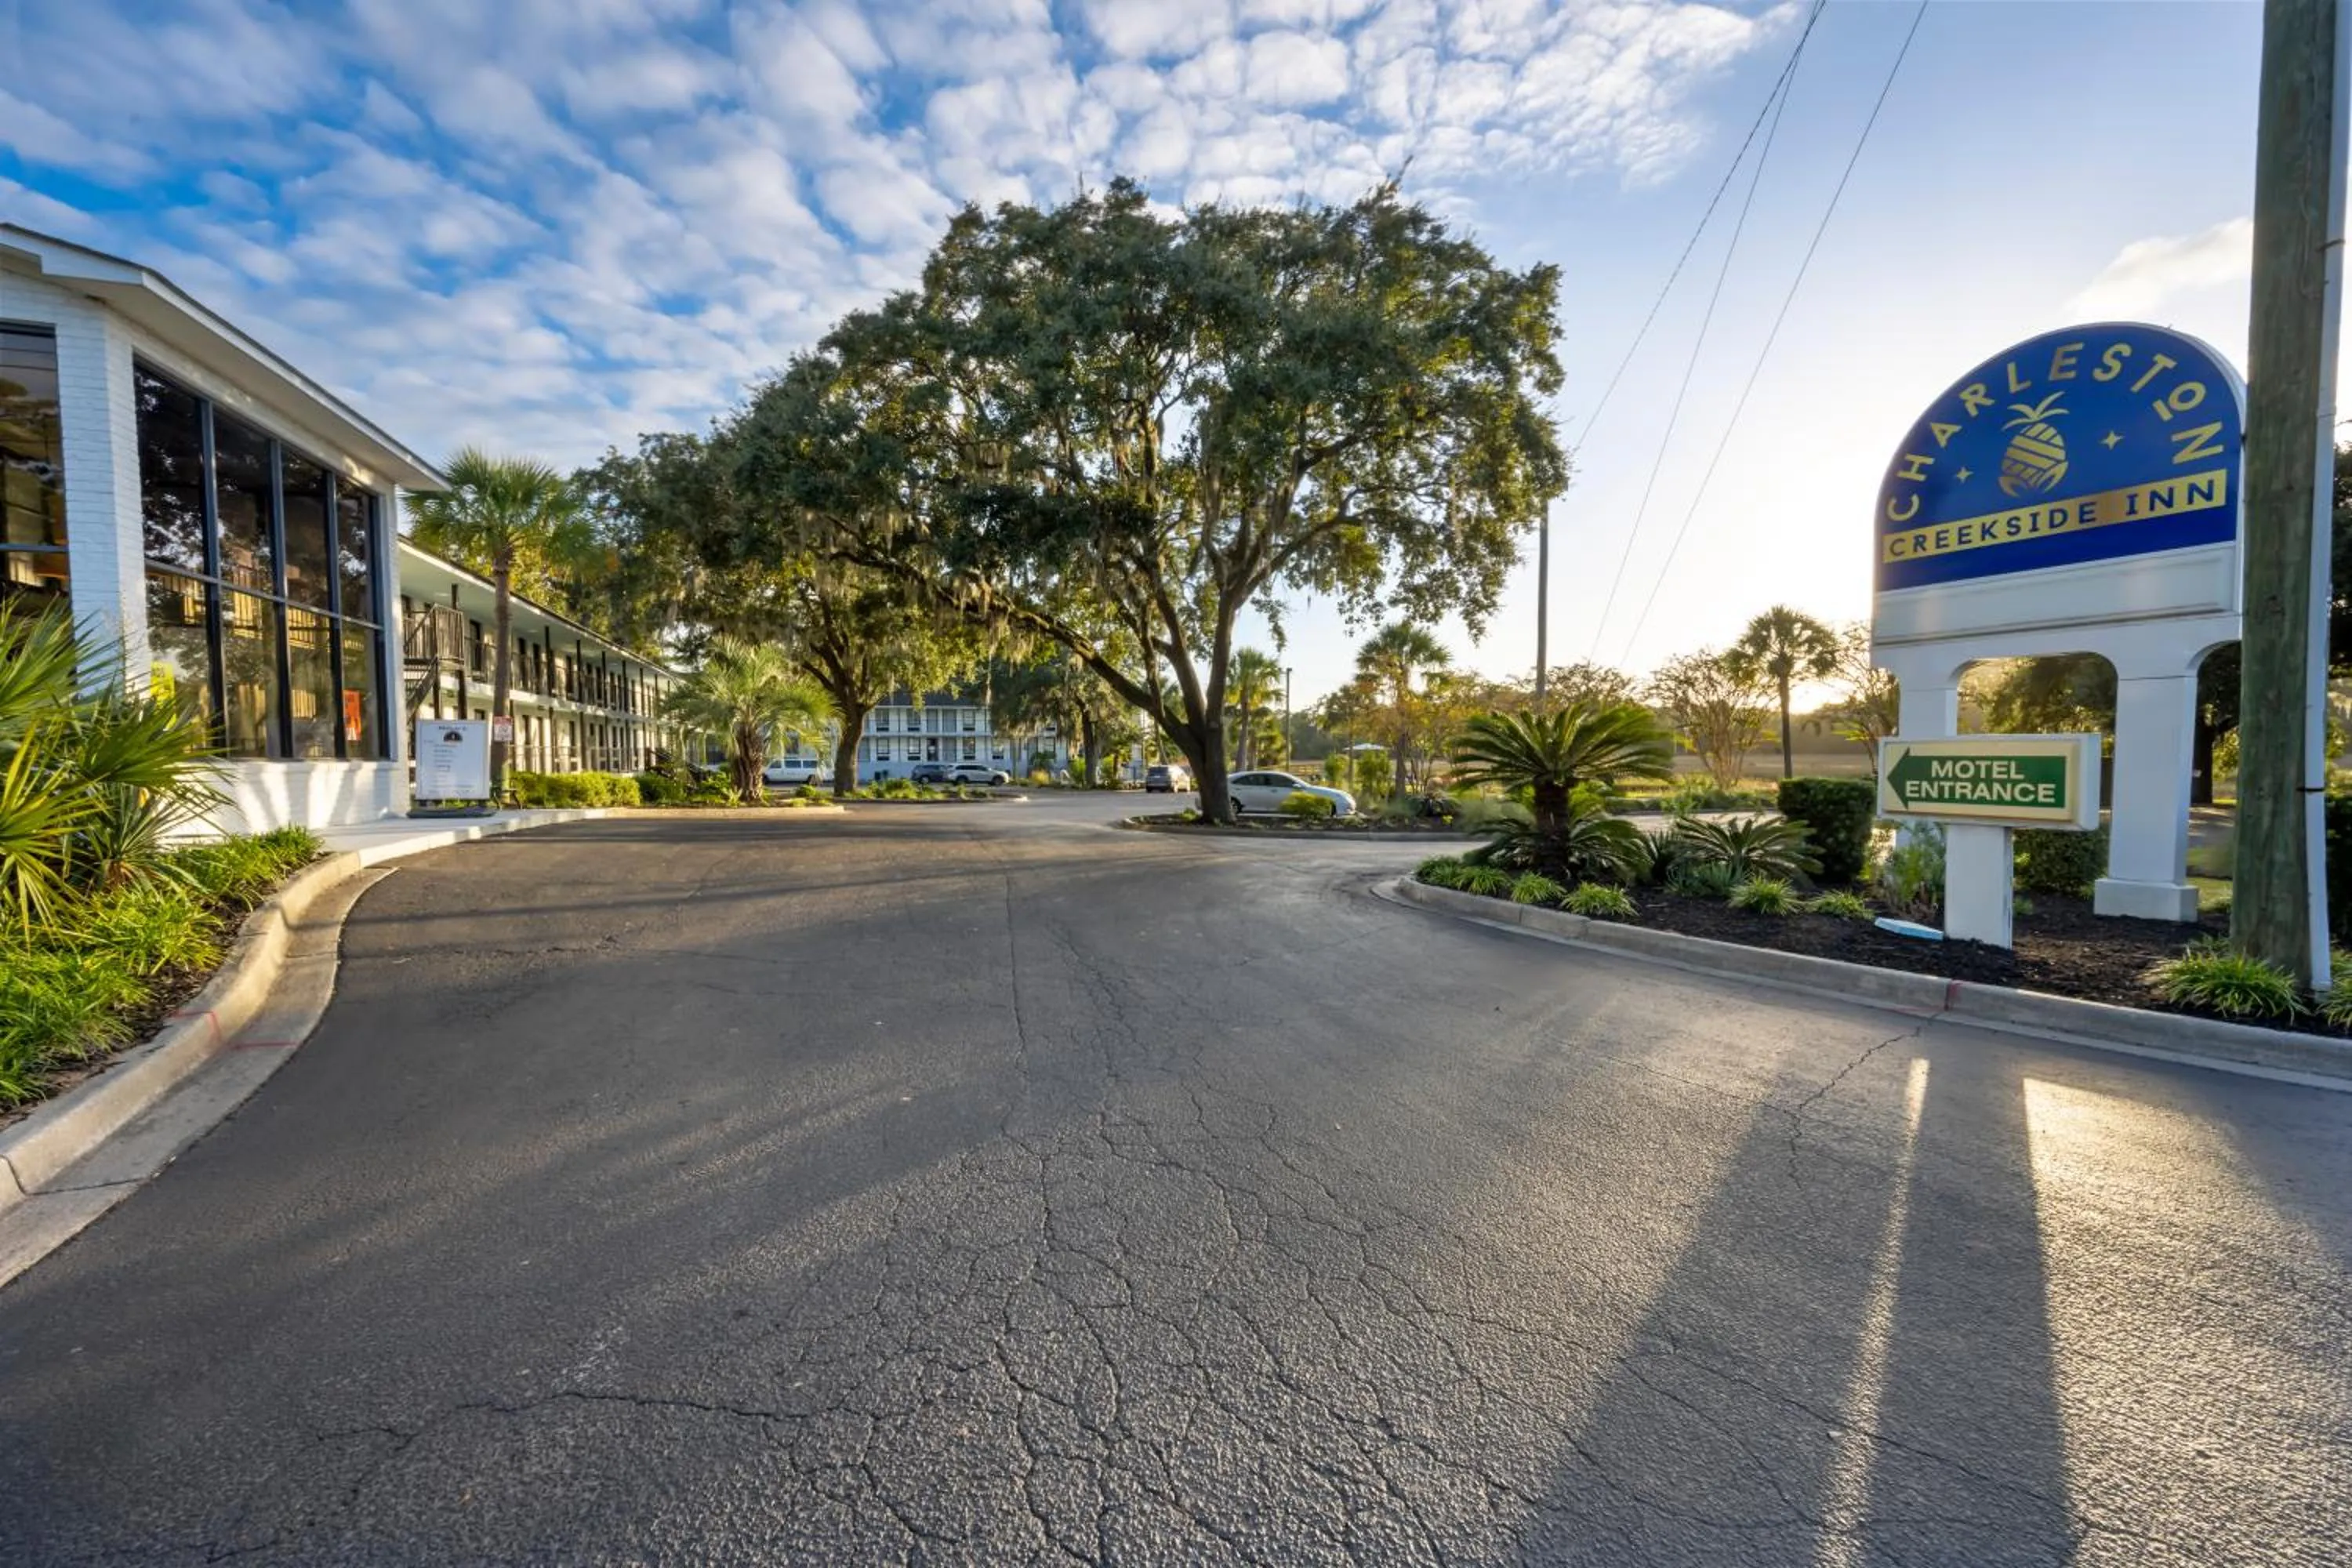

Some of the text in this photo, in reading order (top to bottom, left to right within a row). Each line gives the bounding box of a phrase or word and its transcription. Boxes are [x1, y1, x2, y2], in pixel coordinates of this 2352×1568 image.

[1886, 343, 2224, 521] CHARLESTON
[1889, 479, 2216, 557] CREEKSIDE INN
[1905, 781, 2056, 803] ENTRANCE
[1931, 760, 2025, 779] MOTEL
